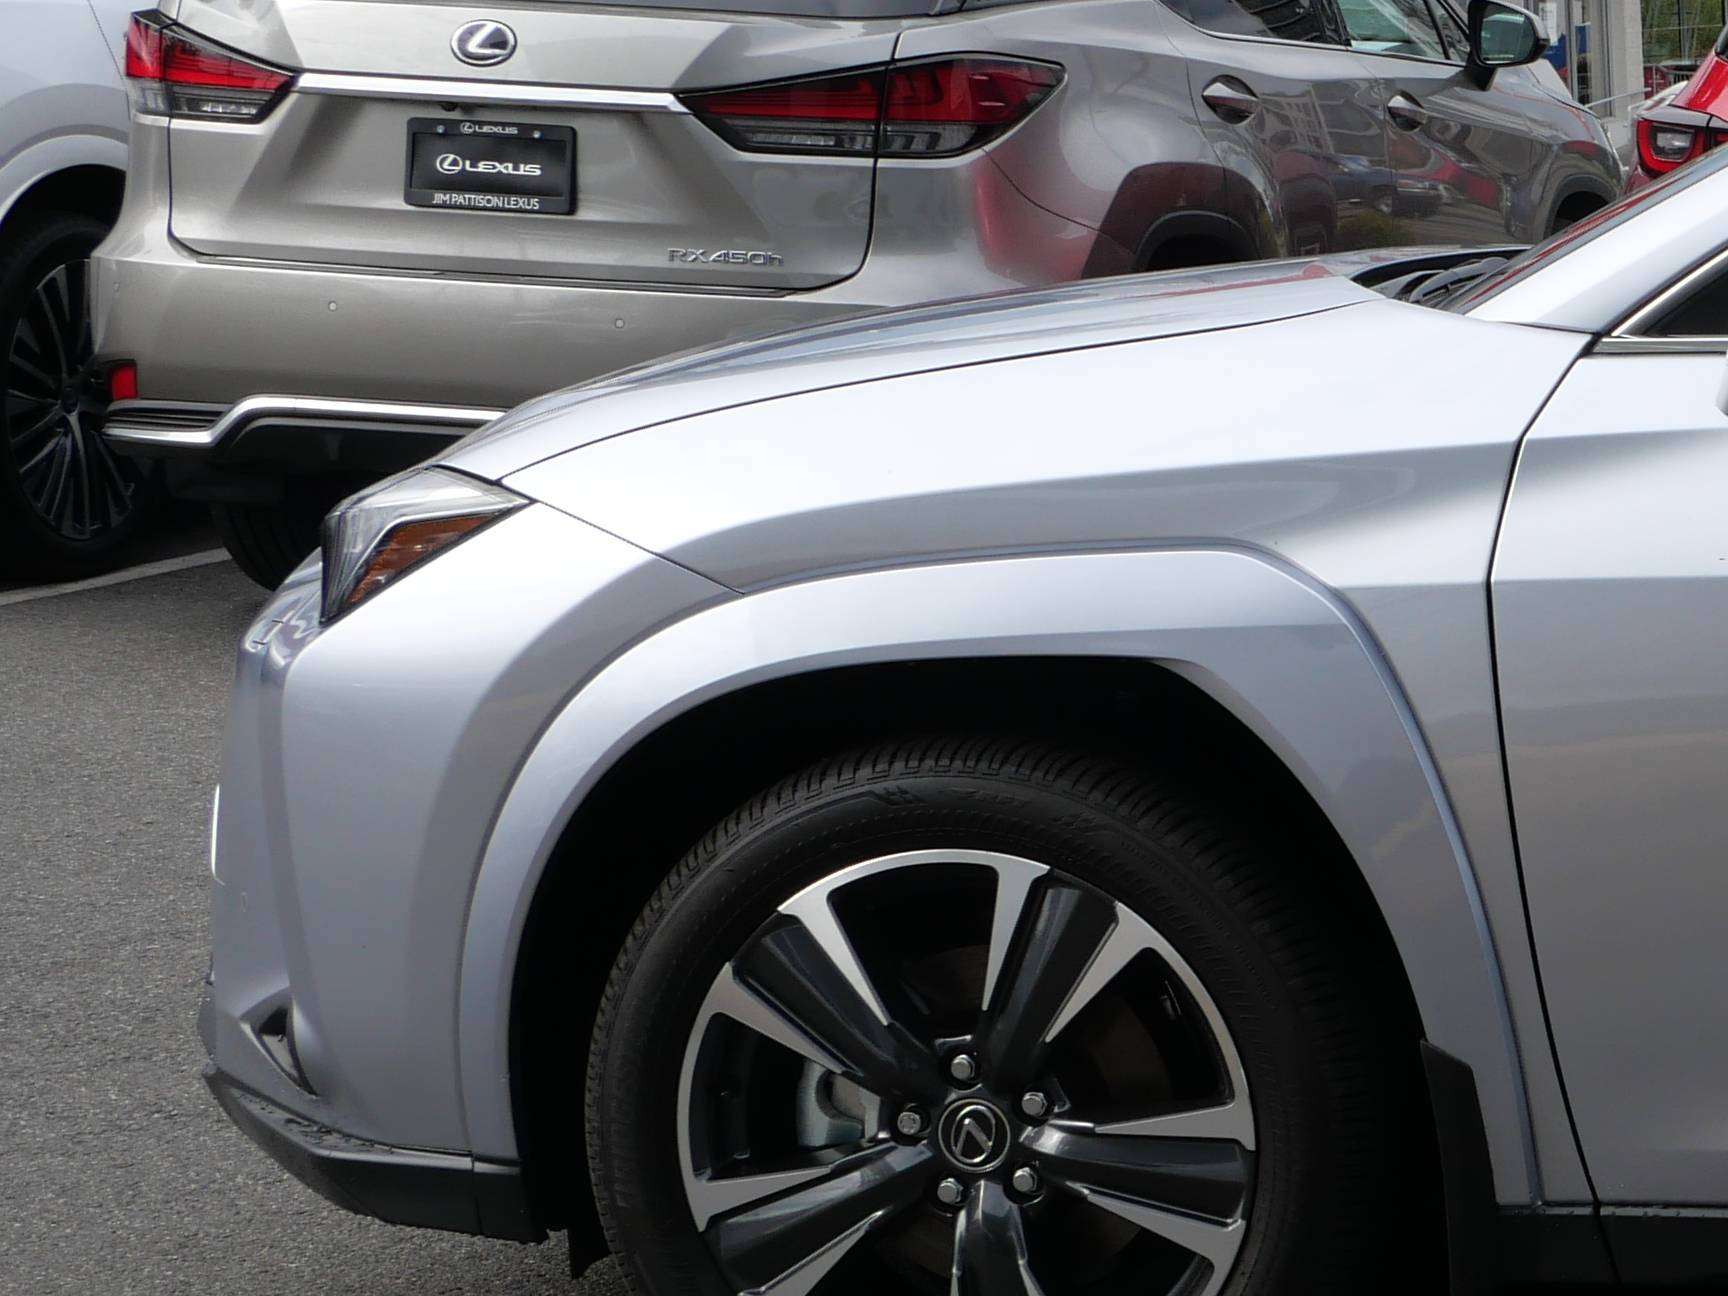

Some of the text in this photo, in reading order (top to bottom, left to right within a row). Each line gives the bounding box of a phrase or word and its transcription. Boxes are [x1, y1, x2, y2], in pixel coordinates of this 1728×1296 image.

[475, 124, 519, 135] LEXUS
[464, 159, 542, 177] LEXUS
[432, 192, 540, 210] JIM PATTISON LEXUS
